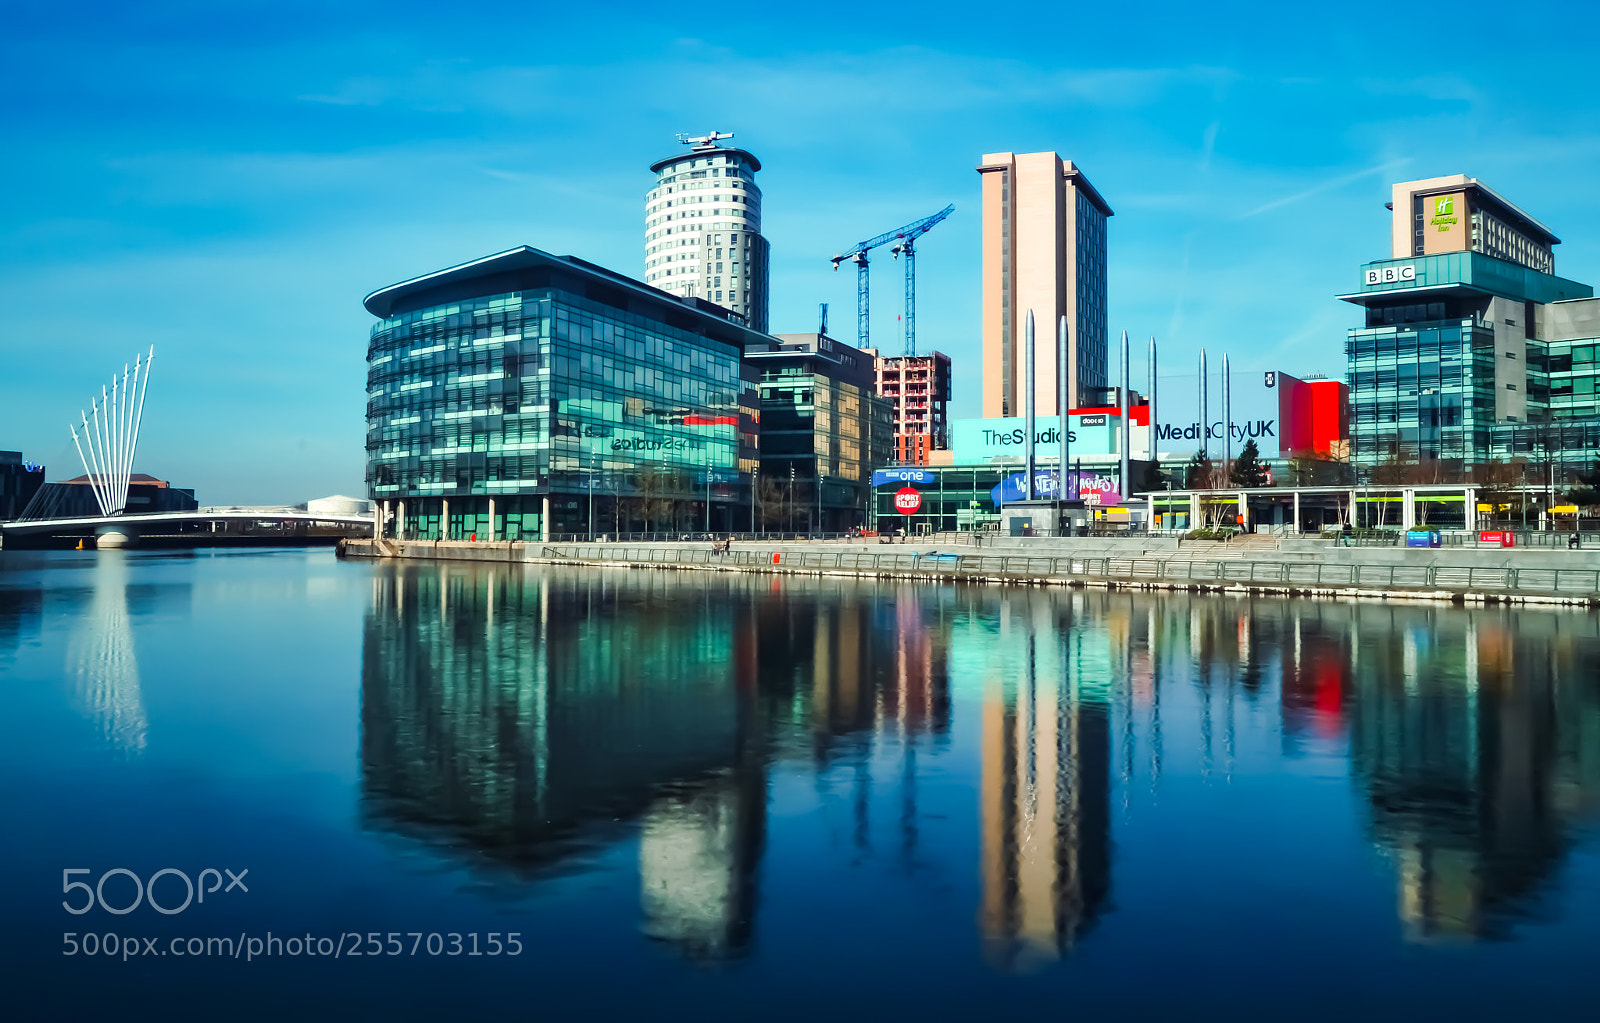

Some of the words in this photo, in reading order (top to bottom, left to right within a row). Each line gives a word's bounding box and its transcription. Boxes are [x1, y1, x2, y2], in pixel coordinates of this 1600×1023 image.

[1430, 217, 1458, 226] Holiday
[1437, 224, 1450, 232] Inn
[1369, 267, 1413, 283] BBC
[1156, 420, 1275, 442] MediCtyUK
[900, 471, 924, 481] one
